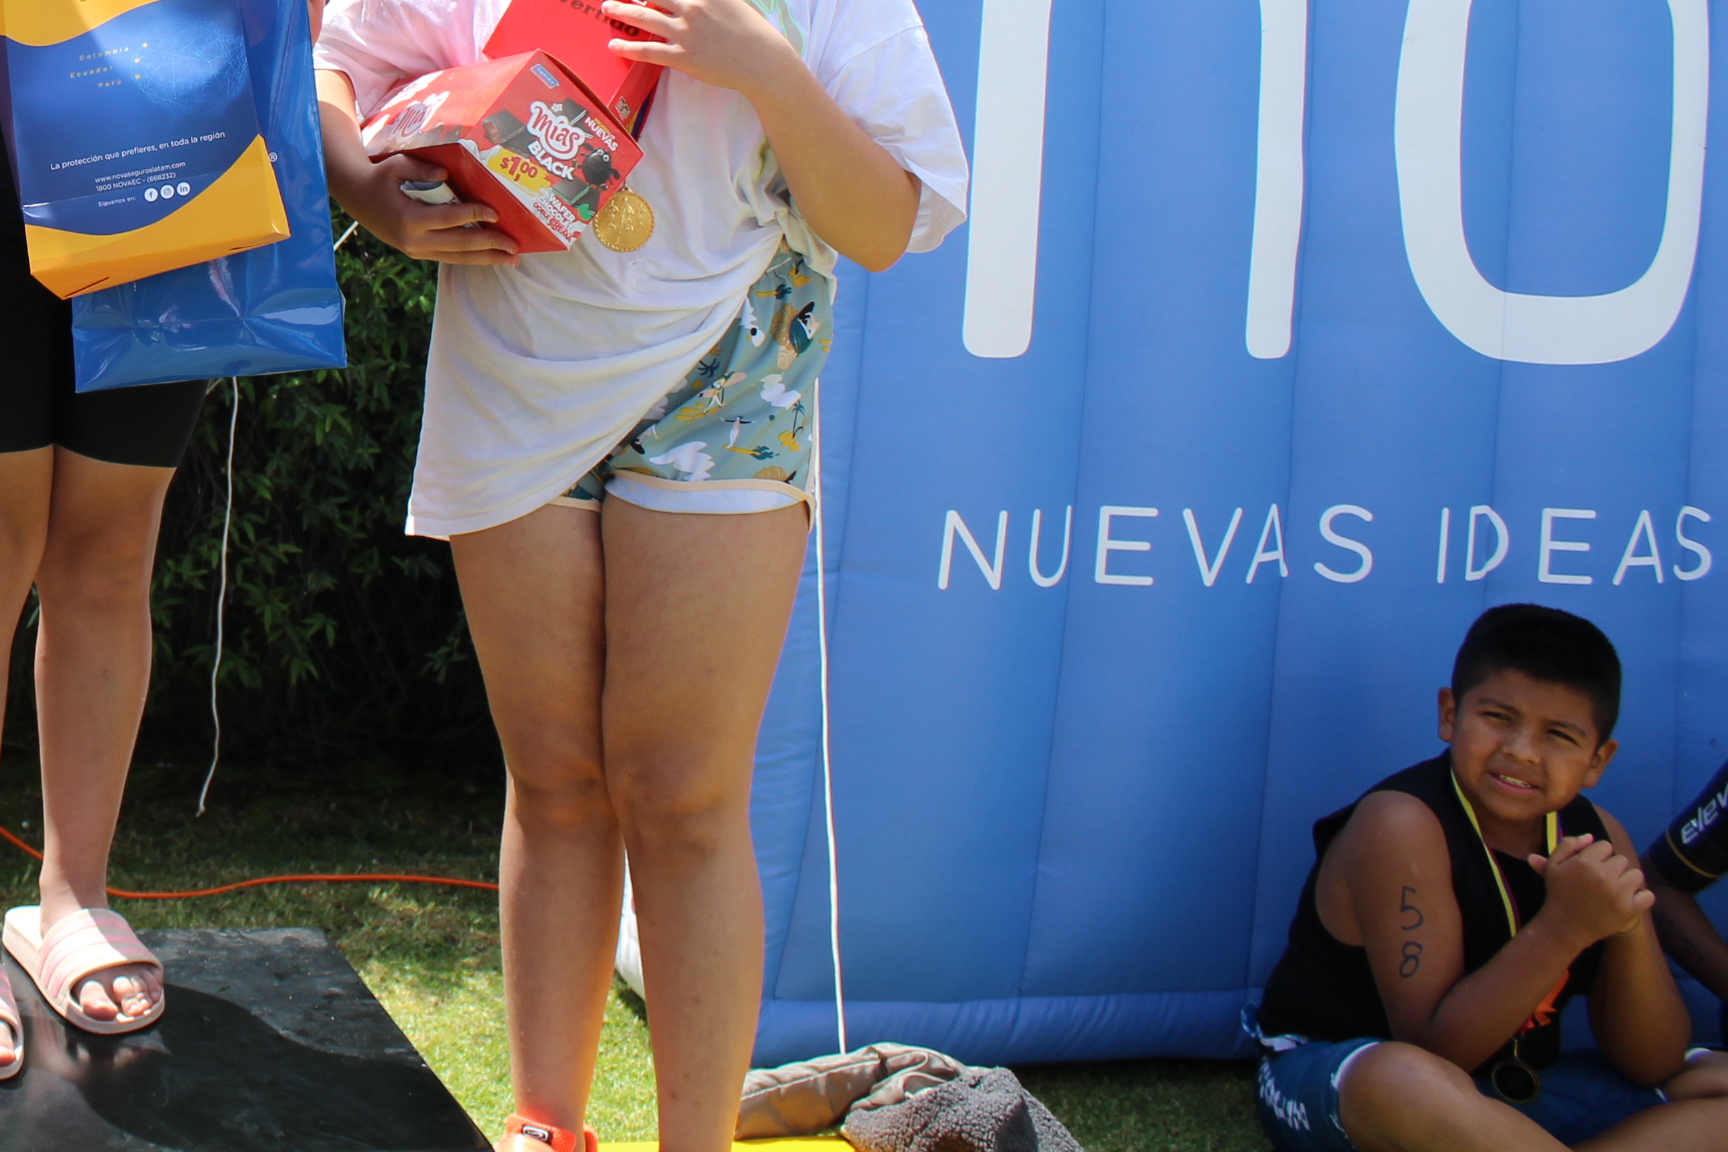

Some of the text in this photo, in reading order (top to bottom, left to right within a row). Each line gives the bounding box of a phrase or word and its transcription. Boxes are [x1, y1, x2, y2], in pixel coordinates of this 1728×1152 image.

[79, 46, 129, 61] Colombia
[70, 65, 113, 78] Ecuador
[584, 116, 618, 151] NUEVAS
[50, 130, 226, 171] La protección que prefieres, en toda la región
[527, 140, 575, 180] BLACK
[94, 160, 187, 184] www.novaseguroslatam.com
[95, 183, 112, 192] 1800
[112, 177, 142, 190] NOVAEC
[549, 193, 576, 222] WAFER
[937, 503, 1713, 590] NUEVAS IDEAS
